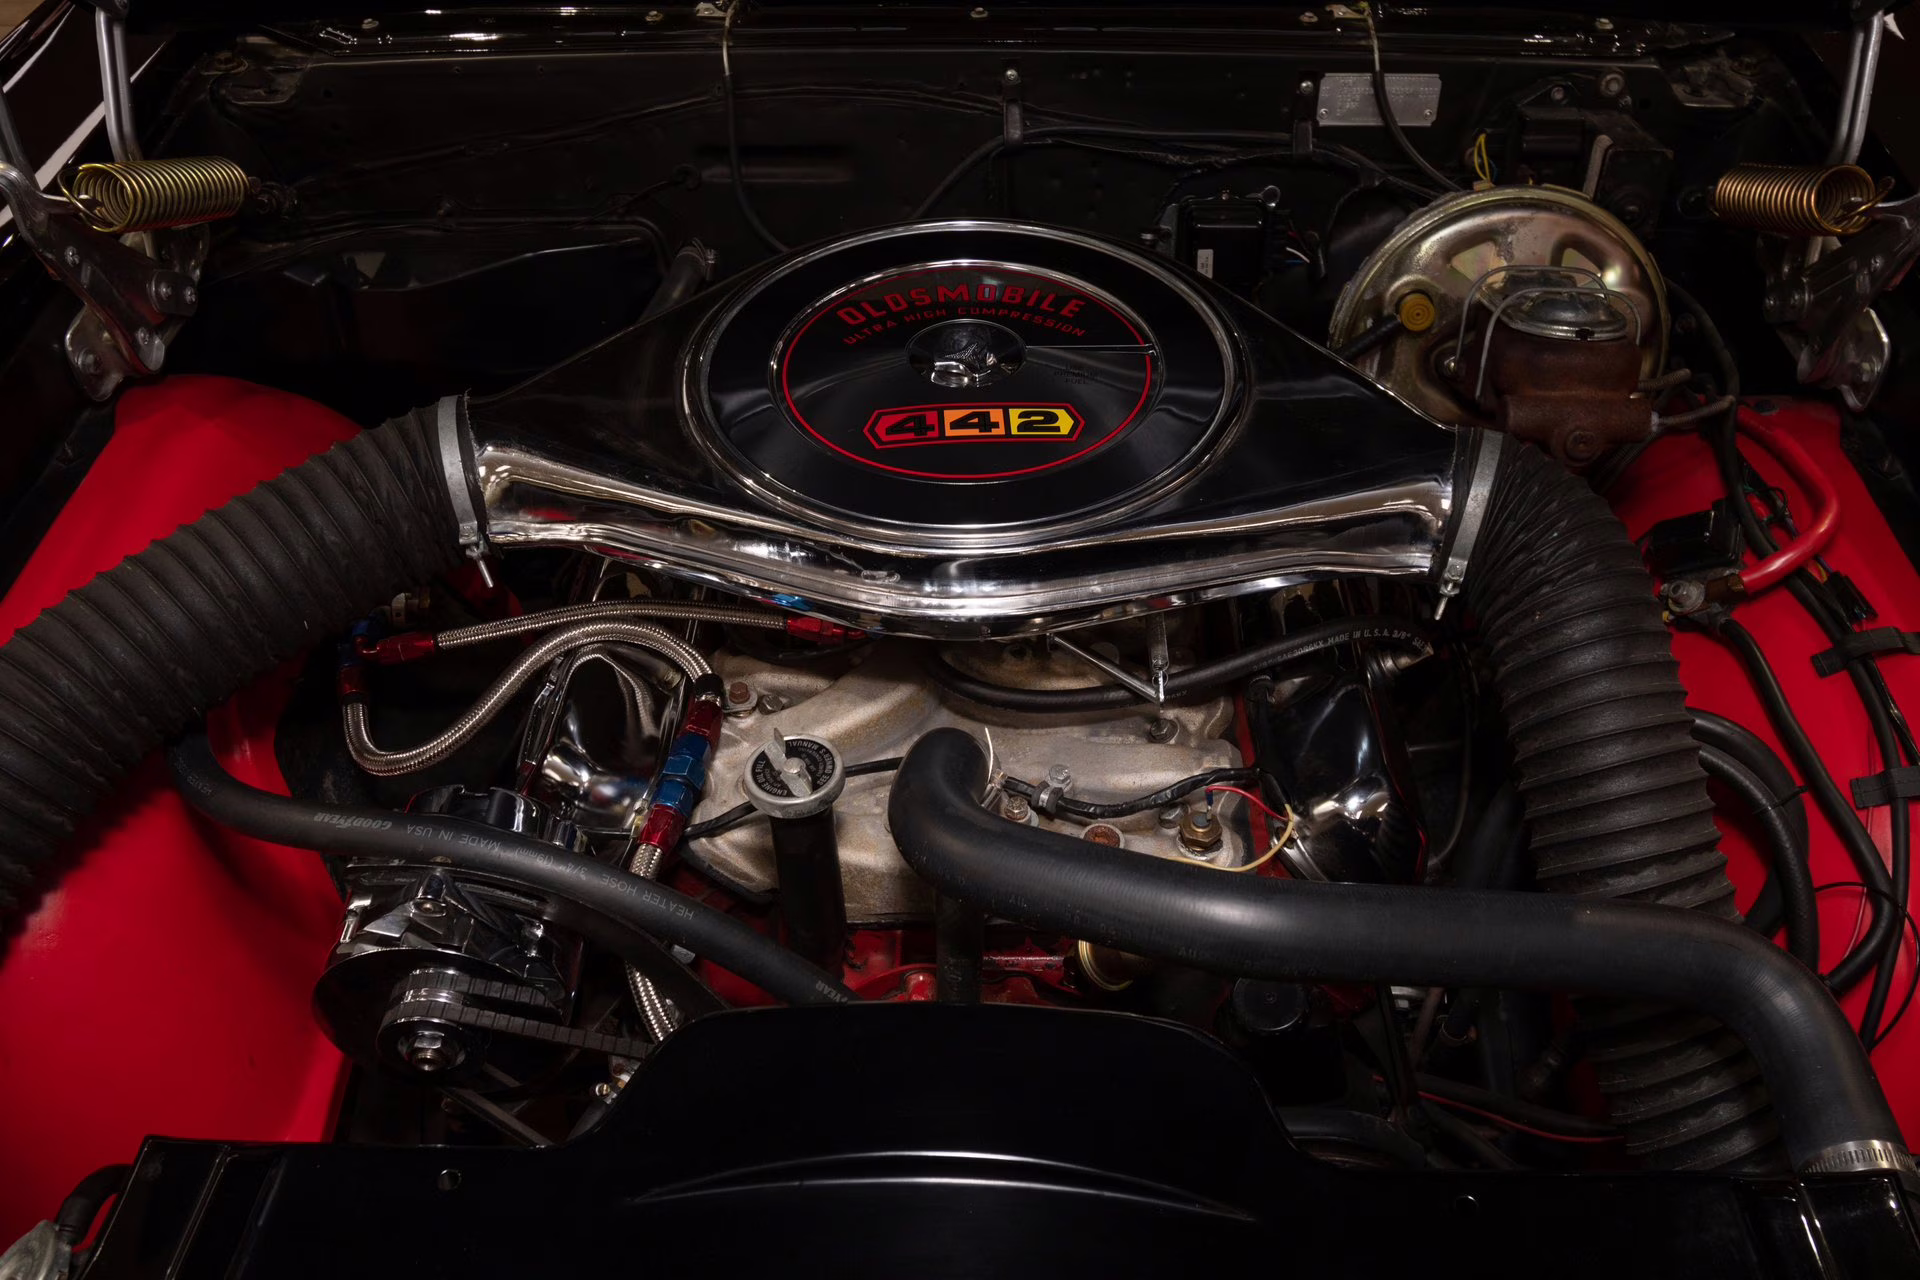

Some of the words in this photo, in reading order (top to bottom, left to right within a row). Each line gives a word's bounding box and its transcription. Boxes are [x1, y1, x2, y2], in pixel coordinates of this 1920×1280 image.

[836, 283, 1087, 327] OLDSMOBILE
[841, 320, 898, 346] ULTRA
[904, 308, 947, 323] HIGH
[957, 307, 1087, 338] COMPRESSION
[1326, 632, 1350, 646] MADE
[1352, 630, 1361, 639] IN
[788, 740, 820, 752] MANUAL
[755, 758, 766, 773] FILL
[756, 773, 766, 784] OIL
[762, 781, 788, 797] ENGINE
[314, 812, 393, 830] GOODYEAR
[406, 823, 432, 838] USA
[438, 829, 453, 842] IN
[458, 833, 501, 851] MADE
[601, 873, 638, 898] HOSE
[643, 889, 694, 921] HEATER
